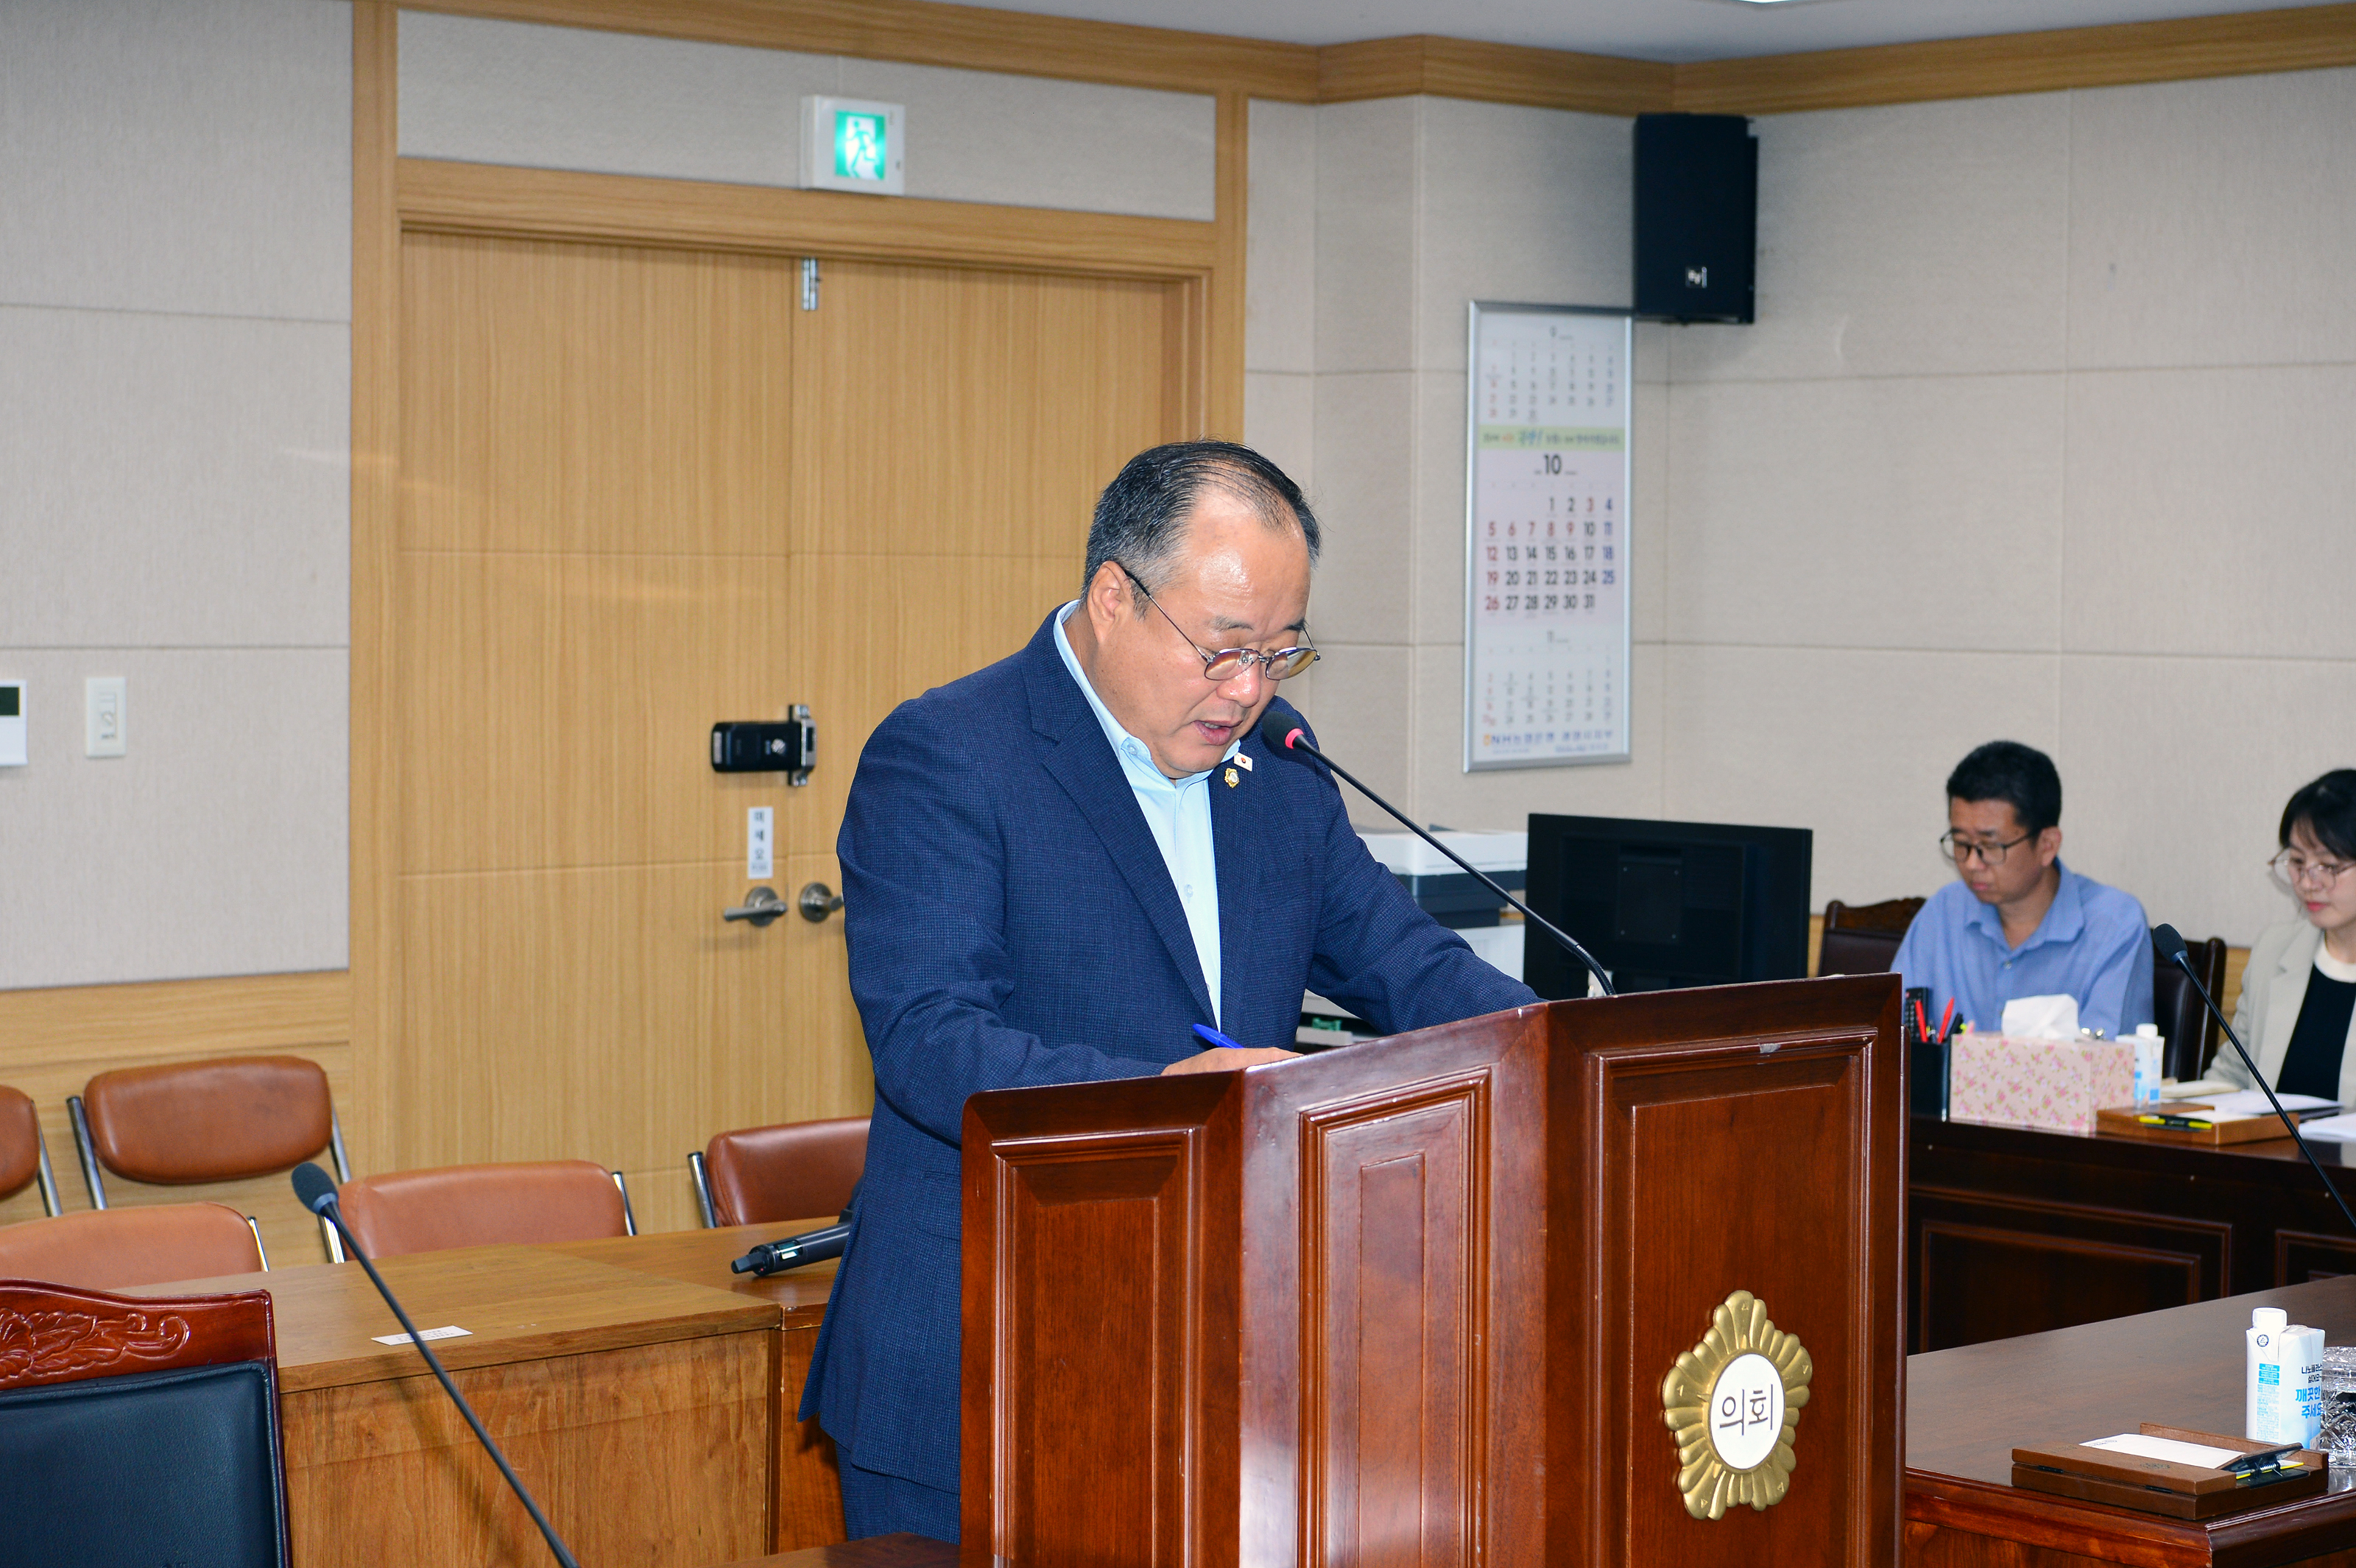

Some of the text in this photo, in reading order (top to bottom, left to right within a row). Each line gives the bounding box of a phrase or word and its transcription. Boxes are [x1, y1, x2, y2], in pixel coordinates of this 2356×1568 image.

[1544, 454, 1562, 475] 10
[1549, 496, 1612, 514] 1 2 3 4
[1489, 521, 1496, 537] 5
[1508, 522, 1516, 537] 6
[1528, 520, 1536, 535] 7
[1548, 521, 1555, 537] 8
[1567, 521, 1574, 536] 9
[1584, 521, 1595, 537] 10
[1486, 545, 1614, 562] 12 13 14 15 16 17 18
[1487, 570, 1615, 586] 19 20 21 22 23 24 25
[1486, 594, 1595, 610] 26 27 28 29 30 31
[2295, 1385, 2321, 1402] 깨끗한
[1719, 1383, 1774, 1436] 의회
